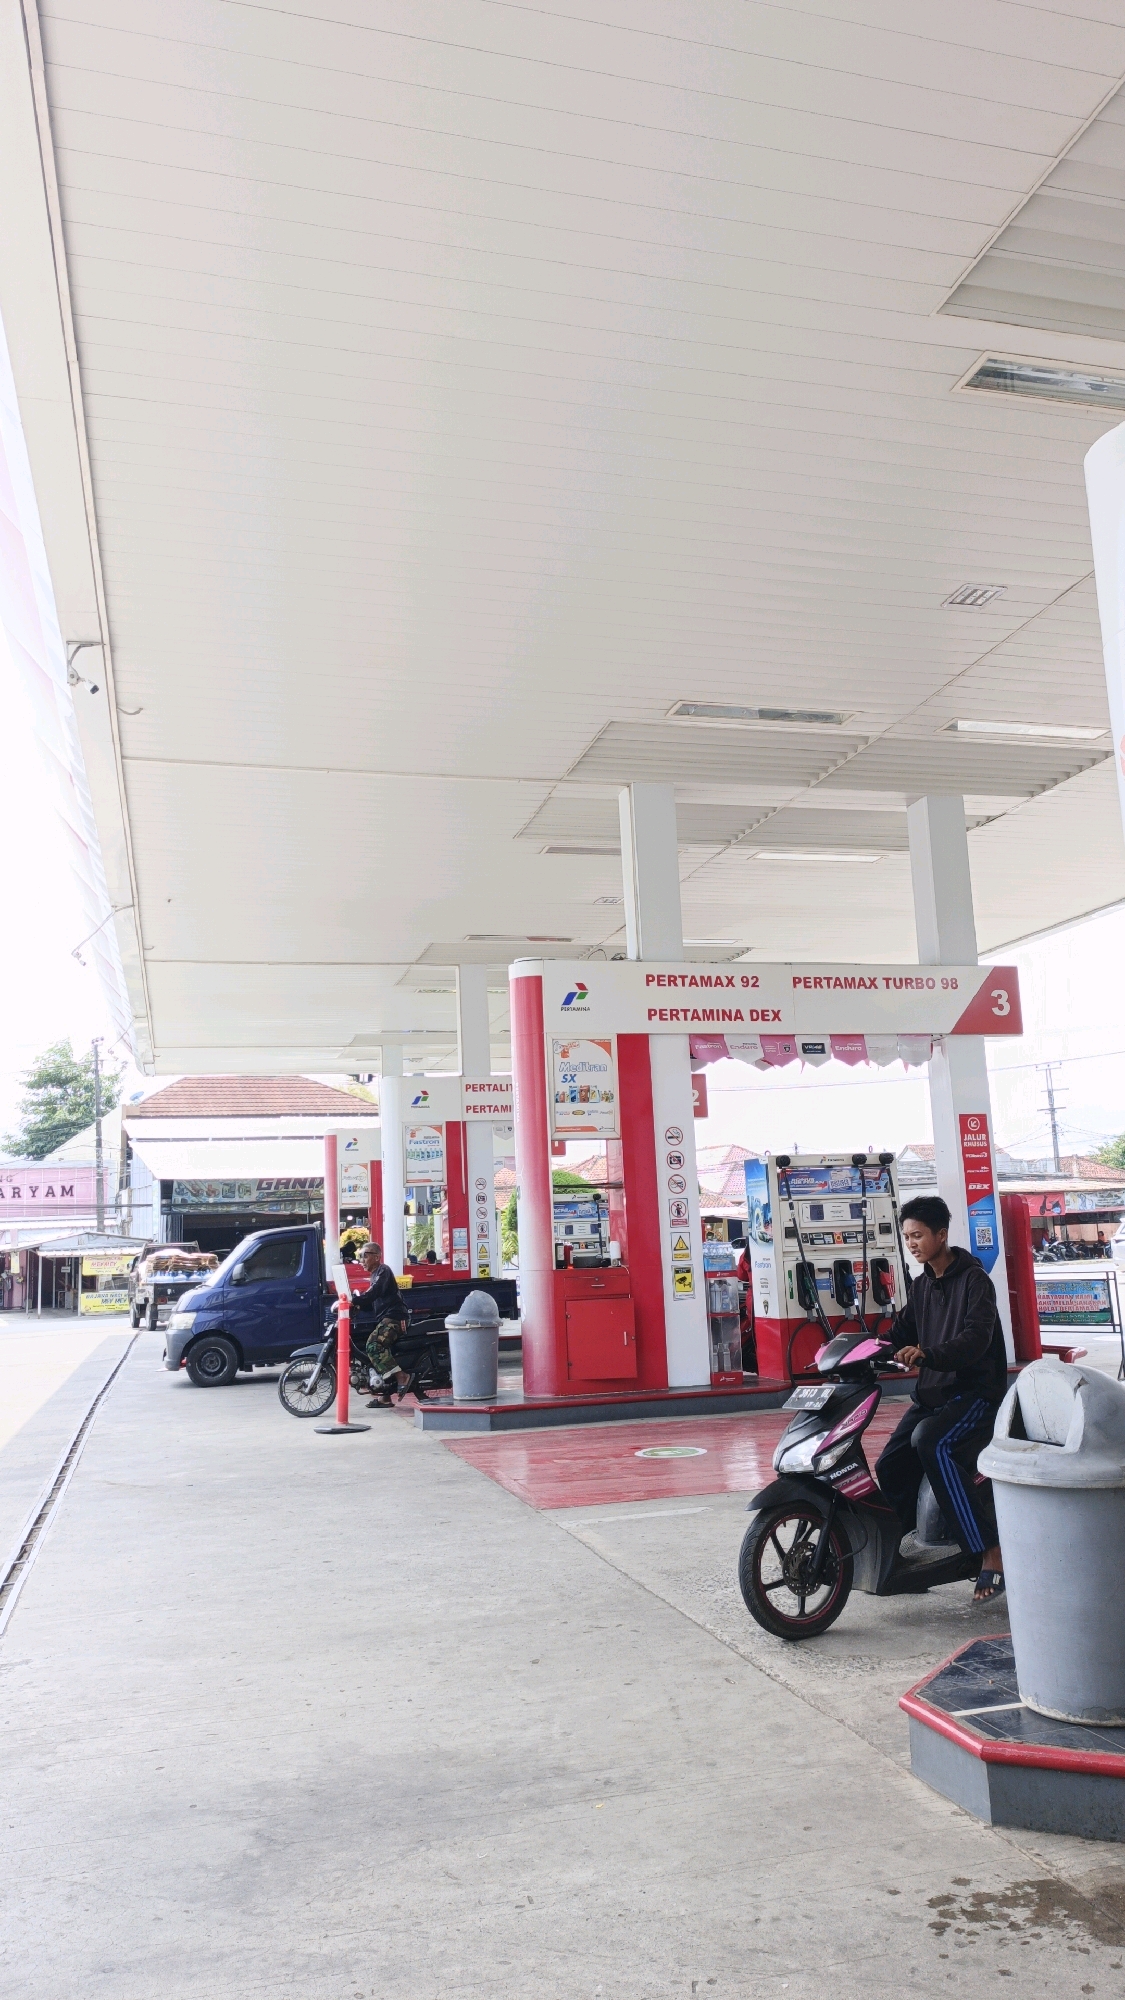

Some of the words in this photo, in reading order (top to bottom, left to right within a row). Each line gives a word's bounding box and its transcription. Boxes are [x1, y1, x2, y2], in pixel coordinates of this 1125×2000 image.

[645, 974, 736, 988] PERTAMAX
[740, 975, 760, 988] 92
[792, 976, 879, 990] PERTAMAX
[882, 977, 936, 990] TURBO
[941, 977, 959, 990] 98
[990, 989, 1011, 1016] 3
[647, 1008, 745, 1022] PERTAMINA
[749, 1009, 782, 1022] DEX
[559, 1061, 607, 1072] Meditran
[561, 1073, 578, 1083] SX
[963, 1133, 987, 1141] JALUR
[829, 1462, 859, 1480] HONDA
